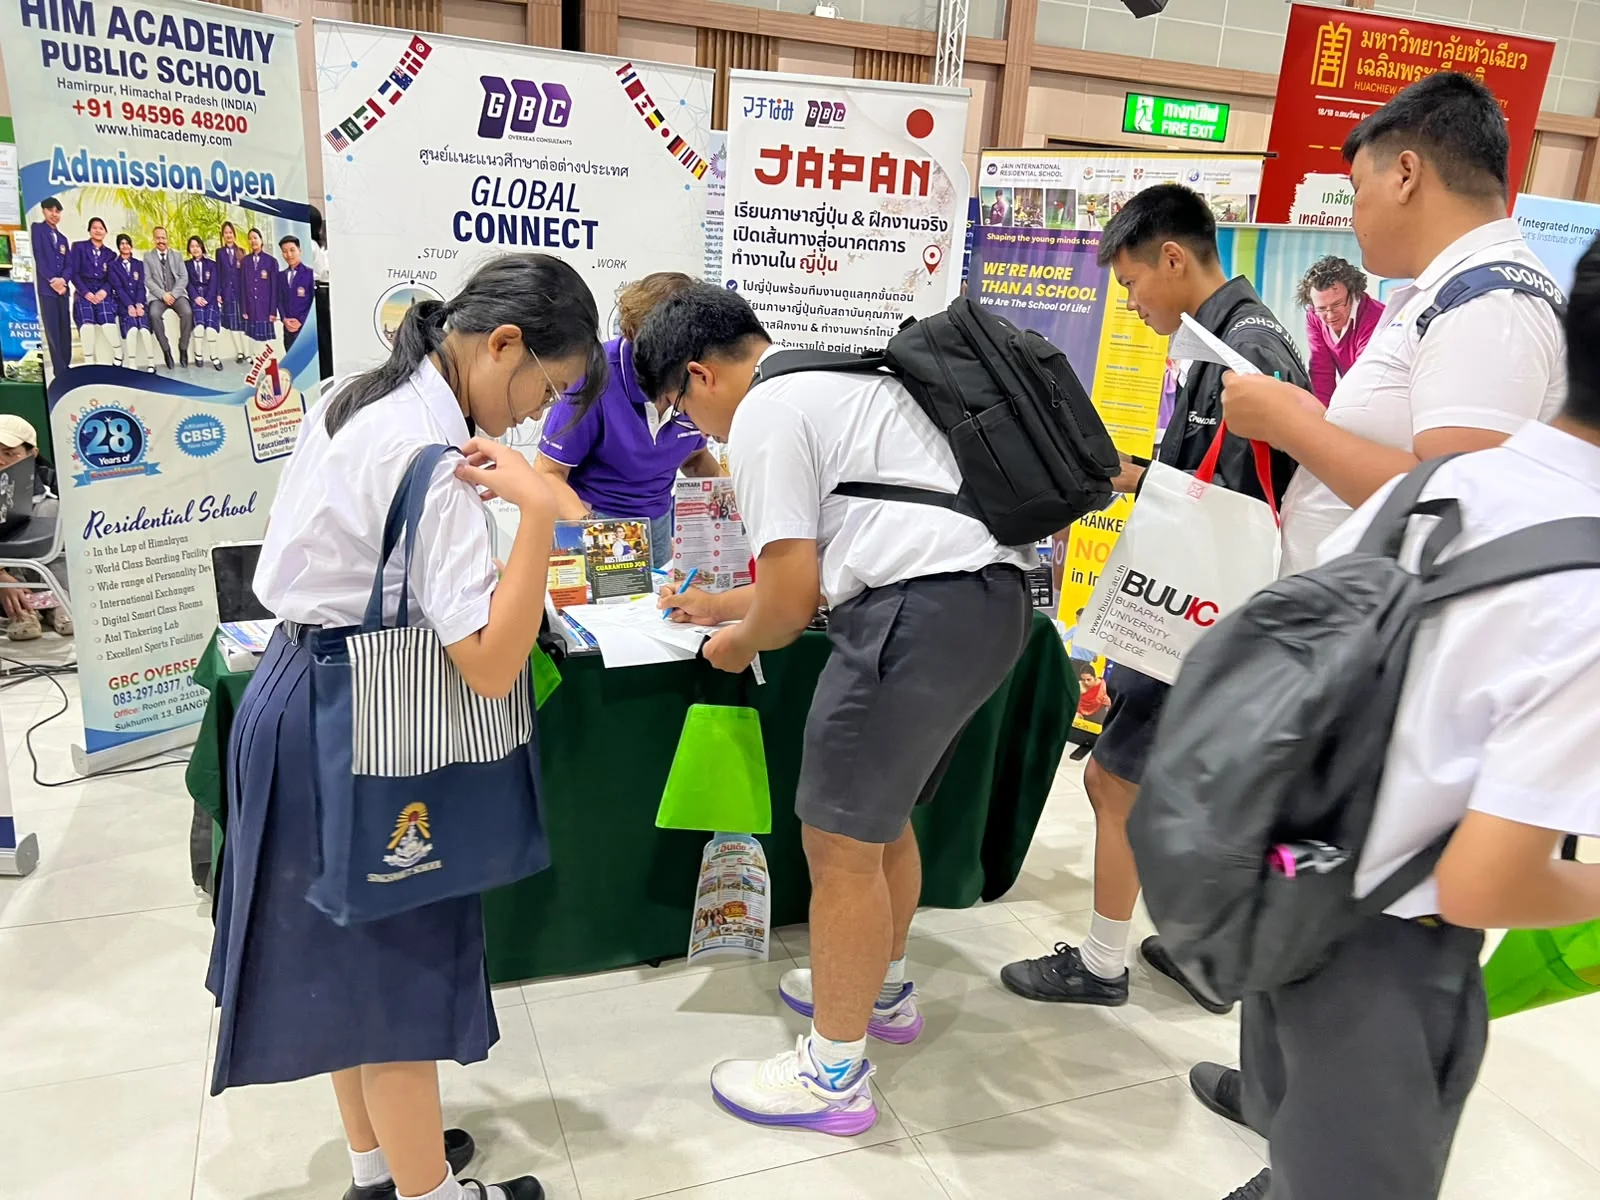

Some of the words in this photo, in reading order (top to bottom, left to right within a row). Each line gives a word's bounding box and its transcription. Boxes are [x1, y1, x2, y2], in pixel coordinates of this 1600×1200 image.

[20, 0, 96, 37] HIM
[107, 6, 275, 64] ACADEMY
[1361, 28, 1528, 71] มหาวิทยาลัยหัวเฉียว
[41, 39, 148, 80] PUBLIC
[157, 56, 266, 97] SCHOOL
[57, 77, 117, 96] Hamirpur,
[120, 85, 172, 102] Himachal
[175, 91, 219, 108] Pradesh
[221, 97, 258, 115] (INDIA)
[1354, 81, 1397, 95] HUACHIEW
[72, 97, 113, 119] +91
[122, 101, 185, 126] 94596
[191, 112, 248, 134] 48200
[1161, 119, 1188, 136] FIRE
[1189, 122, 1216, 138] EXIT
[95, 122, 233, 148] www.himacademy.com
[508, 134, 536, 143] OVERSEAS
[536, 136, 573, 146] CONSULTANTS
[49, 146, 204, 192] Admission
[211, 160, 275, 198] Open
[419, 144, 629, 178] ศูนย์แนะแนวศึกษาต่อต่างประเทศ
[754, 144, 931, 197] JAPAN
[1015, 163, 1061, 171] INTERNATIONAL
[1039, 170, 1063, 178] SCHOOL
[471, 175, 582, 213] GLOBAL
[734, 200, 848, 229] เรียนภาษาญี่ปุ่น
[852, 212, 864, 227] &
[869, 210, 948, 233] ฝึกงานจริง
[1522, 217, 1570, 231] Integrated
[453, 210, 599, 250] CONNECT
[733, 226, 907, 253] เปิดเส้นทางสู่อนาคตการ
[987, 232, 1016, 243] Shaping
[1017, 234, 1031, 242] the
[1032, 236, 1055, 245] young
[1056, 235, 1080, 245] minds
[423, 248, 459, 260] STUDY
[597, 258, 628, 270] WORK
[732, 248, 796, 269] ทำงานใน
[800, 249, 838, 275] ญี่ปุ่น
[387, 268, 438, 280] THAILAND
[983, 262, 1027, 279] WE'RE
[1029, 264, 1073, 281] MORE
[743, 277, 914, 302] ไปญี่ปุ่นพร้อมทีมงานดูแลทุกขั้นตอน
[981, 279, 1021, 295] THAN
[1021, 282, 1032, 296] A
[1035, 282, 1097, 302] SCHOOL
[1489, 266, 1562, 304] SCHOOL
[979, 296, 994, 306] We
[994, 298, 1009, 308] Are
[1011, 298, 1026, 310] The
[1028, 300, 1058, 312] School
[1059, 302, 1070, 312] Of
[1071, 303, 1091, 314] Life!
[10, 331, 31, 339] AND
[811, 323, 819, 332] &
[245, 343, 275, 386] Ranked
[265, 358, 282, 396] 1
[84, 418, 133, 455] 28
[181, 427, 221, 444] CBSE
[261, 430, 279, 439] Since
[280, 425, 296, 434] 2017
[98, 456, 121, 466] Years
[122, 454, 131, 463] of
[82, 499, 195, 540] Residential
[198, 491, 258, 522] School
[93, 547, 102, 557] In
[105, 545, 118, 556] the
[120, 543, 137, 557] Lap
[139, 540, 146, 550] of
[148, 535, 189, 549] Himalayas
[95, 562, 120, 575] World
[122, 558, 143, 570] Class
[145, 553, 180, 567] Boarding
[182, 547, 209, 561] Facility
[596, 561, 633, 572] GUARANTEED
[97, 579, 119, 592] Wide
[121, 577, 144, 591] range
[147, 572, 154, 583] of
[155, 566, 197, 582] Personality
[1072, 568, 1083, 583] in
[100, 593, 153, 609] International
[155, 585, 195, 600] Exchanges
[1089, 564, 1126, 635] www.buuic.ac.th
[1121, 569, 1220, 627] BUUIC
[102, 612, 130, 627] Digital
[132, 609, 156, 621] Smart
[157, 604, 177, 615] Class
[178, 600, 203, 611] Rooms
[1115, 596, 1165, 625] BURAPHA
[104, 632, 121, 644] Atal
[124, 625, 162, 640] Tinkering
[164, 620, 180, 631] Lab
[1109, 610, 1171, 640] UNIVERSITY
[106, 648, 143, 661] Excellent
[145, 640, 168, 653] Sports
[170, 632, 203, 646] Facilities
[1099, 631, 1147, 658] COLLEGE
[1104, 619, 1183, 661] INTERNATIONAL
[108, 672, 139, 691] GBC
[113, 706, 139, 719] Office:
[142, 699, 166, 711] Room
[168, 696, 178, 705] no
[115, 712, 159, 731] Sukhumvit
